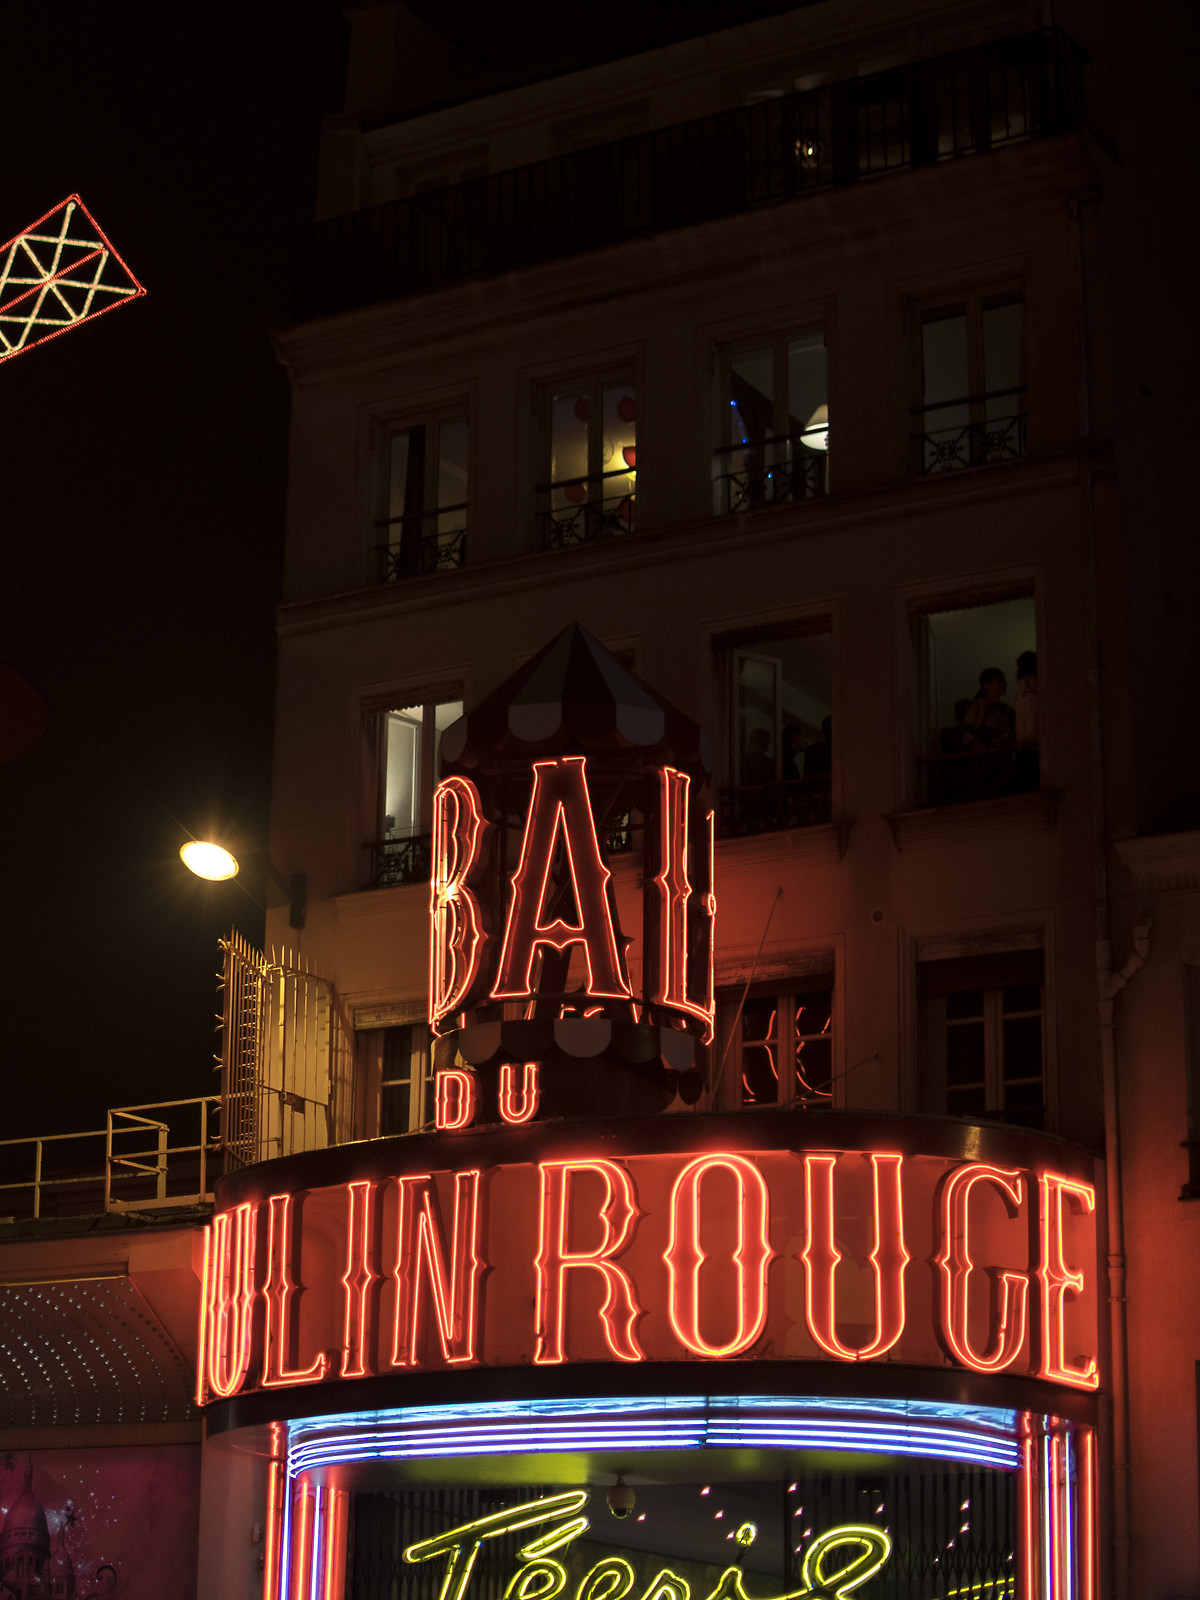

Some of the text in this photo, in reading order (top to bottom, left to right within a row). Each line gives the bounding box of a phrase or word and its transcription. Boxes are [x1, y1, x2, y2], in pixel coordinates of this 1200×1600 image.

[428, 756, 716, 1027] BAL
[435, 1063, 538, 1129] DU
[532, 1152, 1100, 1390] ROUGE
